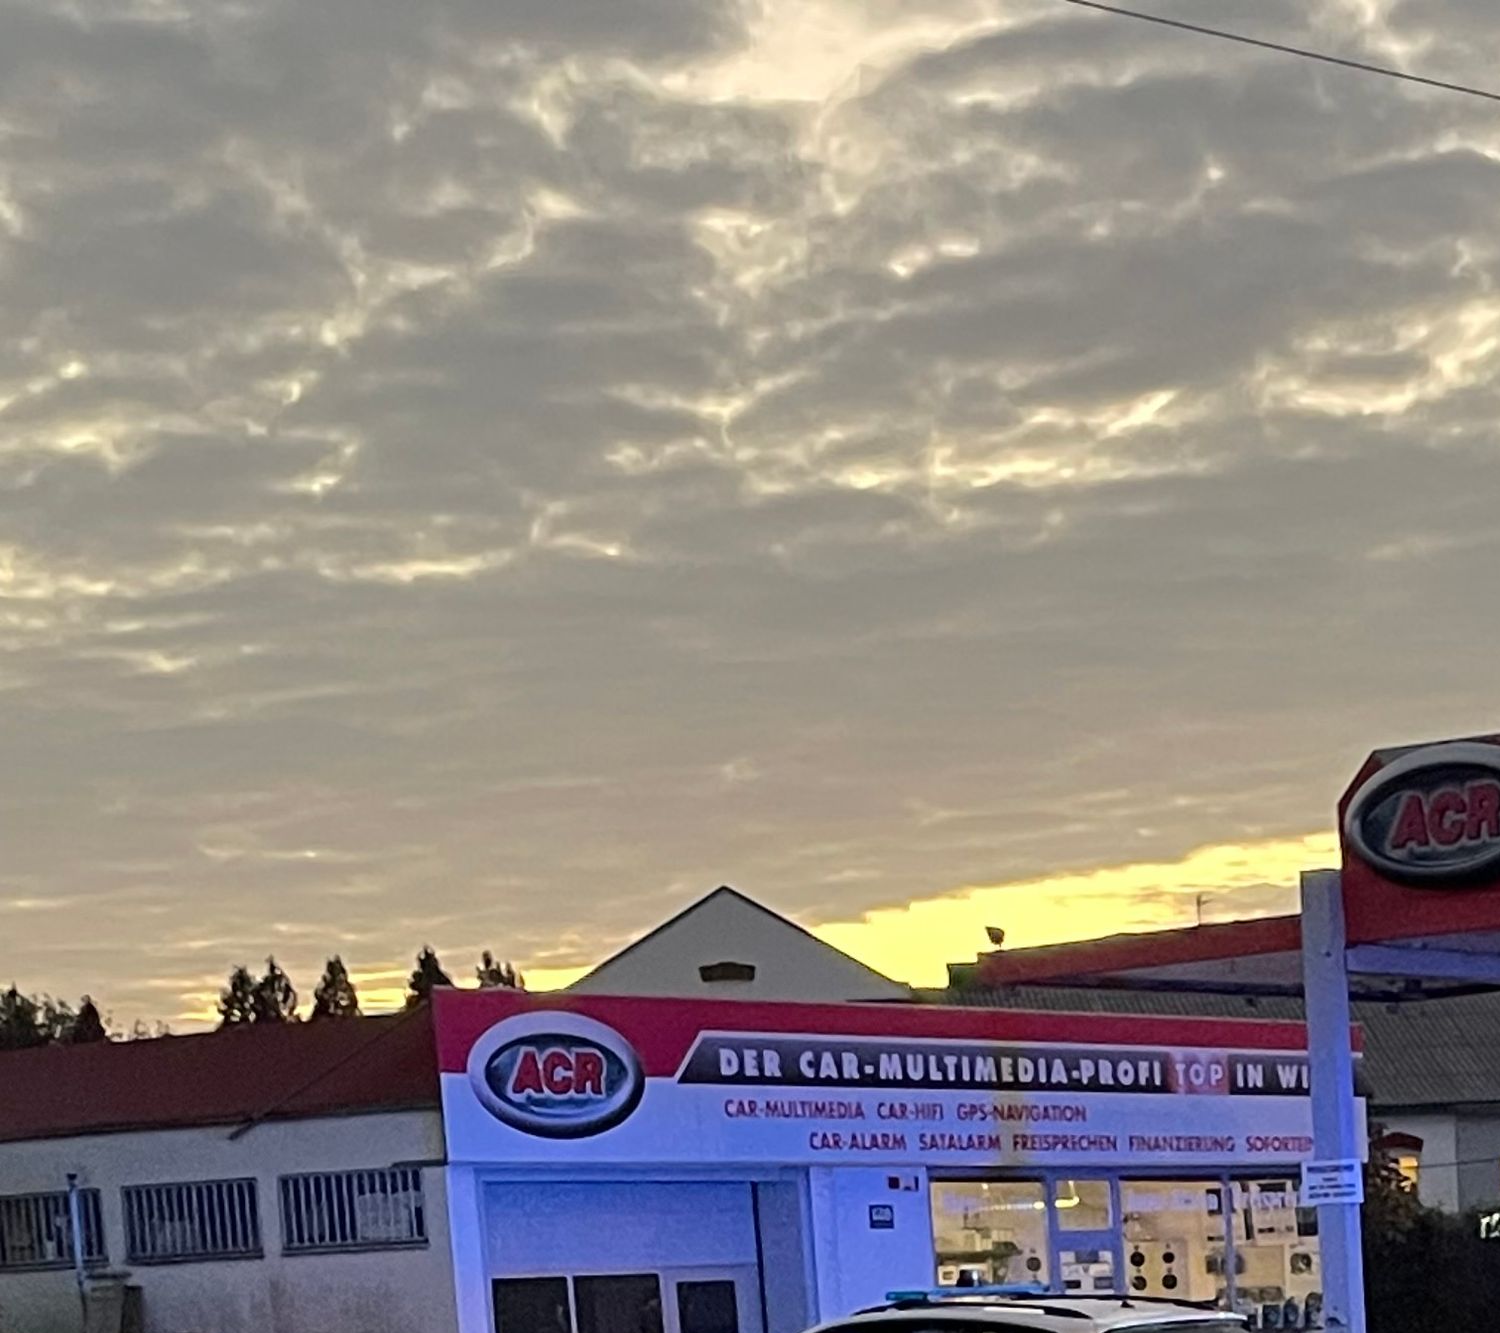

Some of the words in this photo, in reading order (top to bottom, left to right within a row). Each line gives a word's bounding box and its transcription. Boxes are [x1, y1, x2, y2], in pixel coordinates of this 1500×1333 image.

[511, 1047, 606, 1098] ACR
[719, 1048, 782, 1078] DER
[799, 1051, 1162, 1087] CAR-MULTIMEDIA-PROFI
[1175, 1062, 1224, 1087] TOP
[1236, 1063, 1264, 1088] IN
[724, 1099, 866, 1120] CAR-MULTIMEDIA
[957, 1102, 1087, 1123] GPS-NAVIGATION
[809, 1131, 907, 1151] CAR-ALARM
